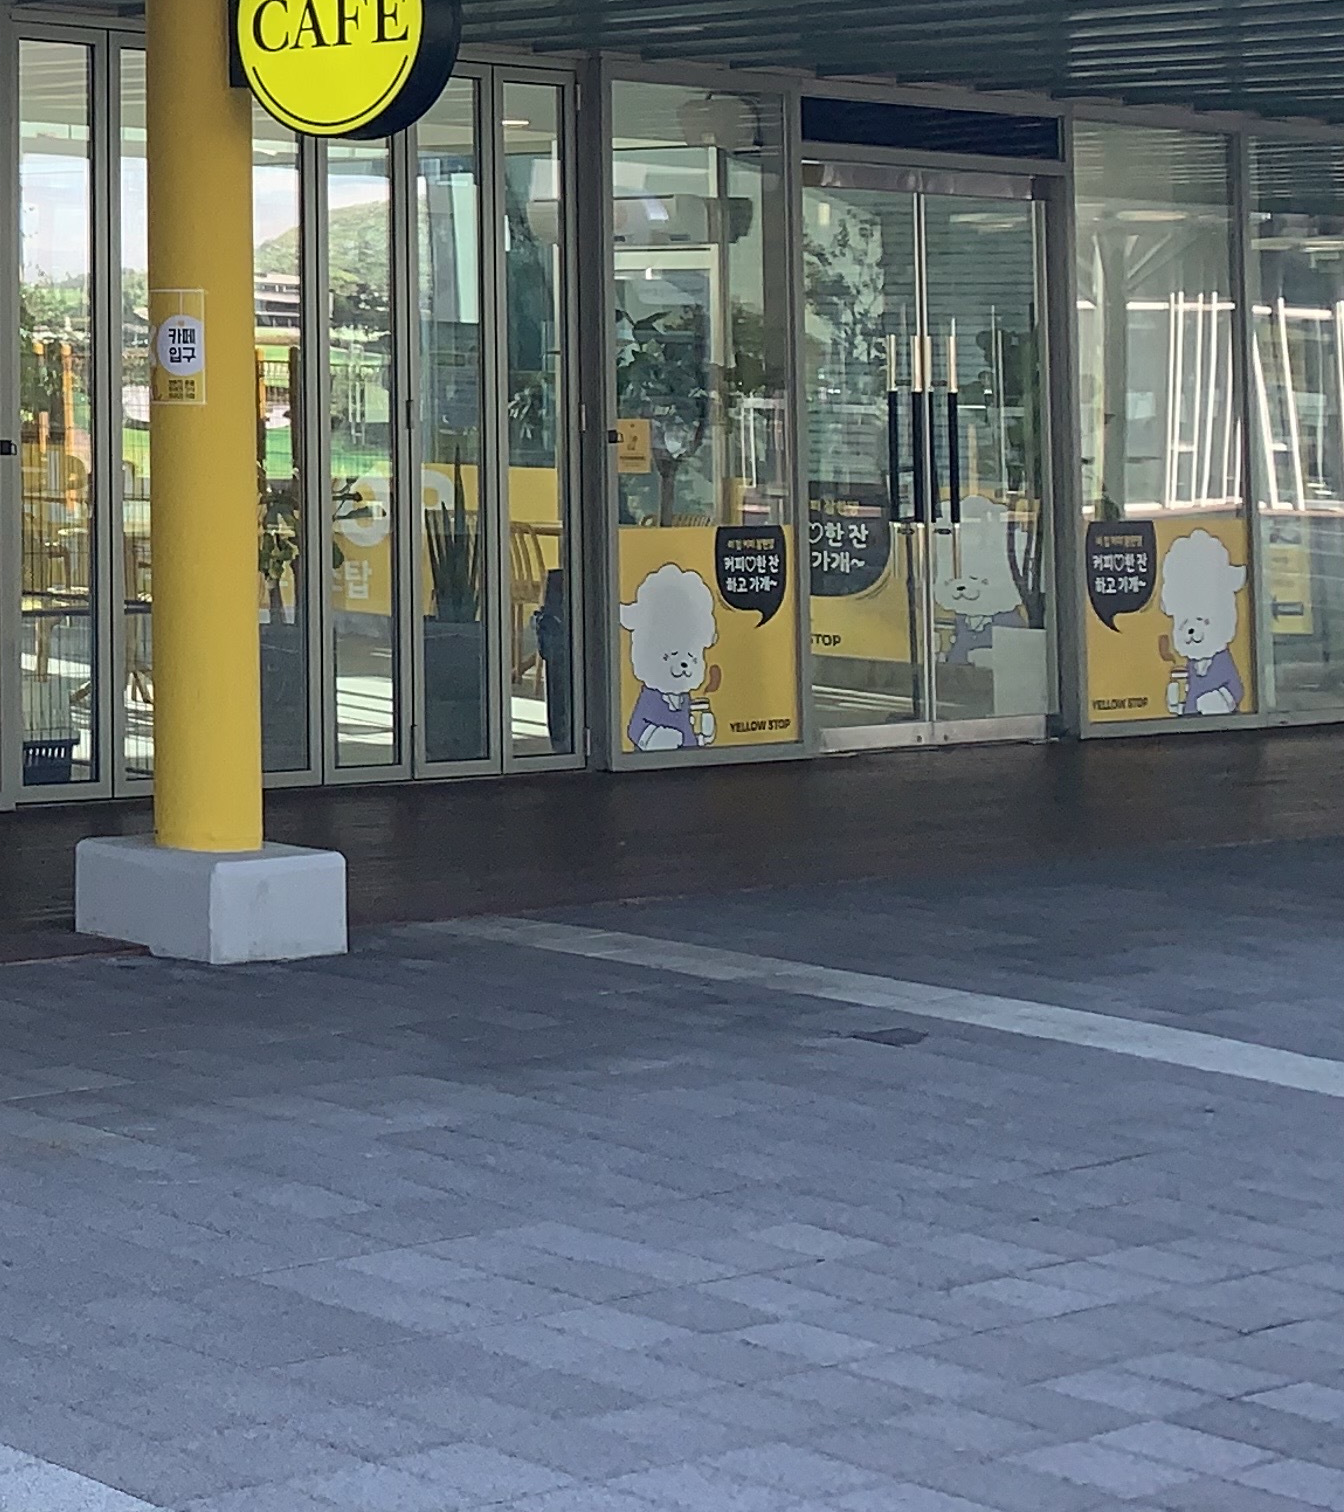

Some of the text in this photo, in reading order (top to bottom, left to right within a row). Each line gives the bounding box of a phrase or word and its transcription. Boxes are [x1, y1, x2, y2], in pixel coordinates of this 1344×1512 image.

[168, 328, 196, 345] 카페
[169, 347, 196, 363] 입구
[848, 523, 870, 550] 잔
[1092, 698, 1126, 711] YELLOW
[729, 718, 792, 733] YELLOW STOP
